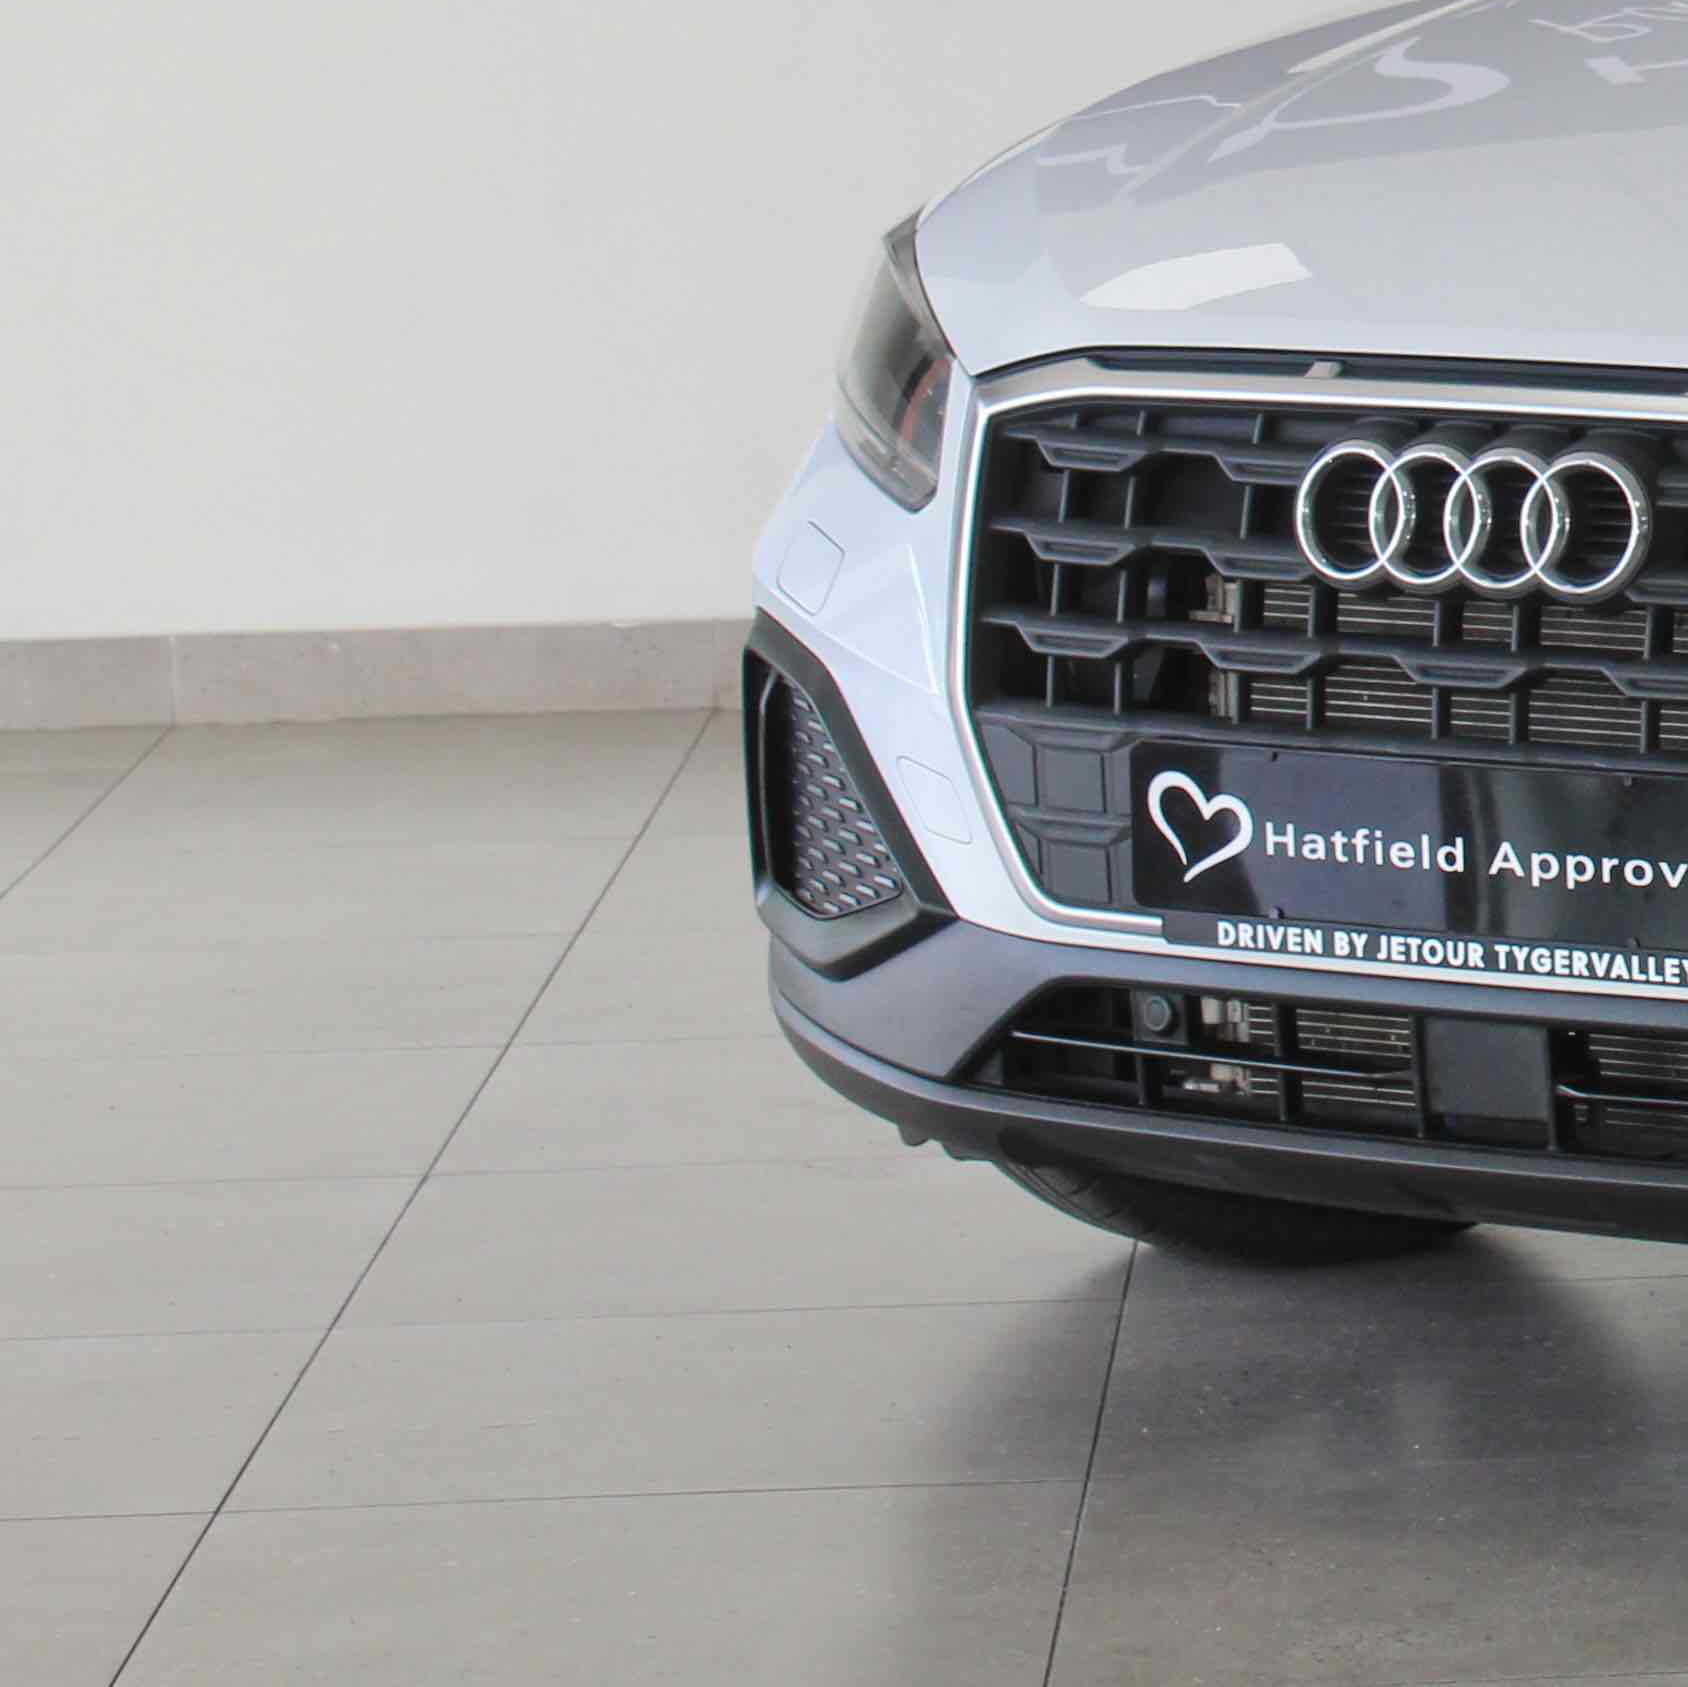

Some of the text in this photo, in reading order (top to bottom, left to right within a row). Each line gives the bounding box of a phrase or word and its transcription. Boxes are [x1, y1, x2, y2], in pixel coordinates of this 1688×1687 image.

[1264, 820, 1465, 873] Hatfield
[1216, 920, 1323, 955] DRIVEN
[1333, 930, 1368, 958] BY
[1376, 933, 1485, 969] JETOUR
